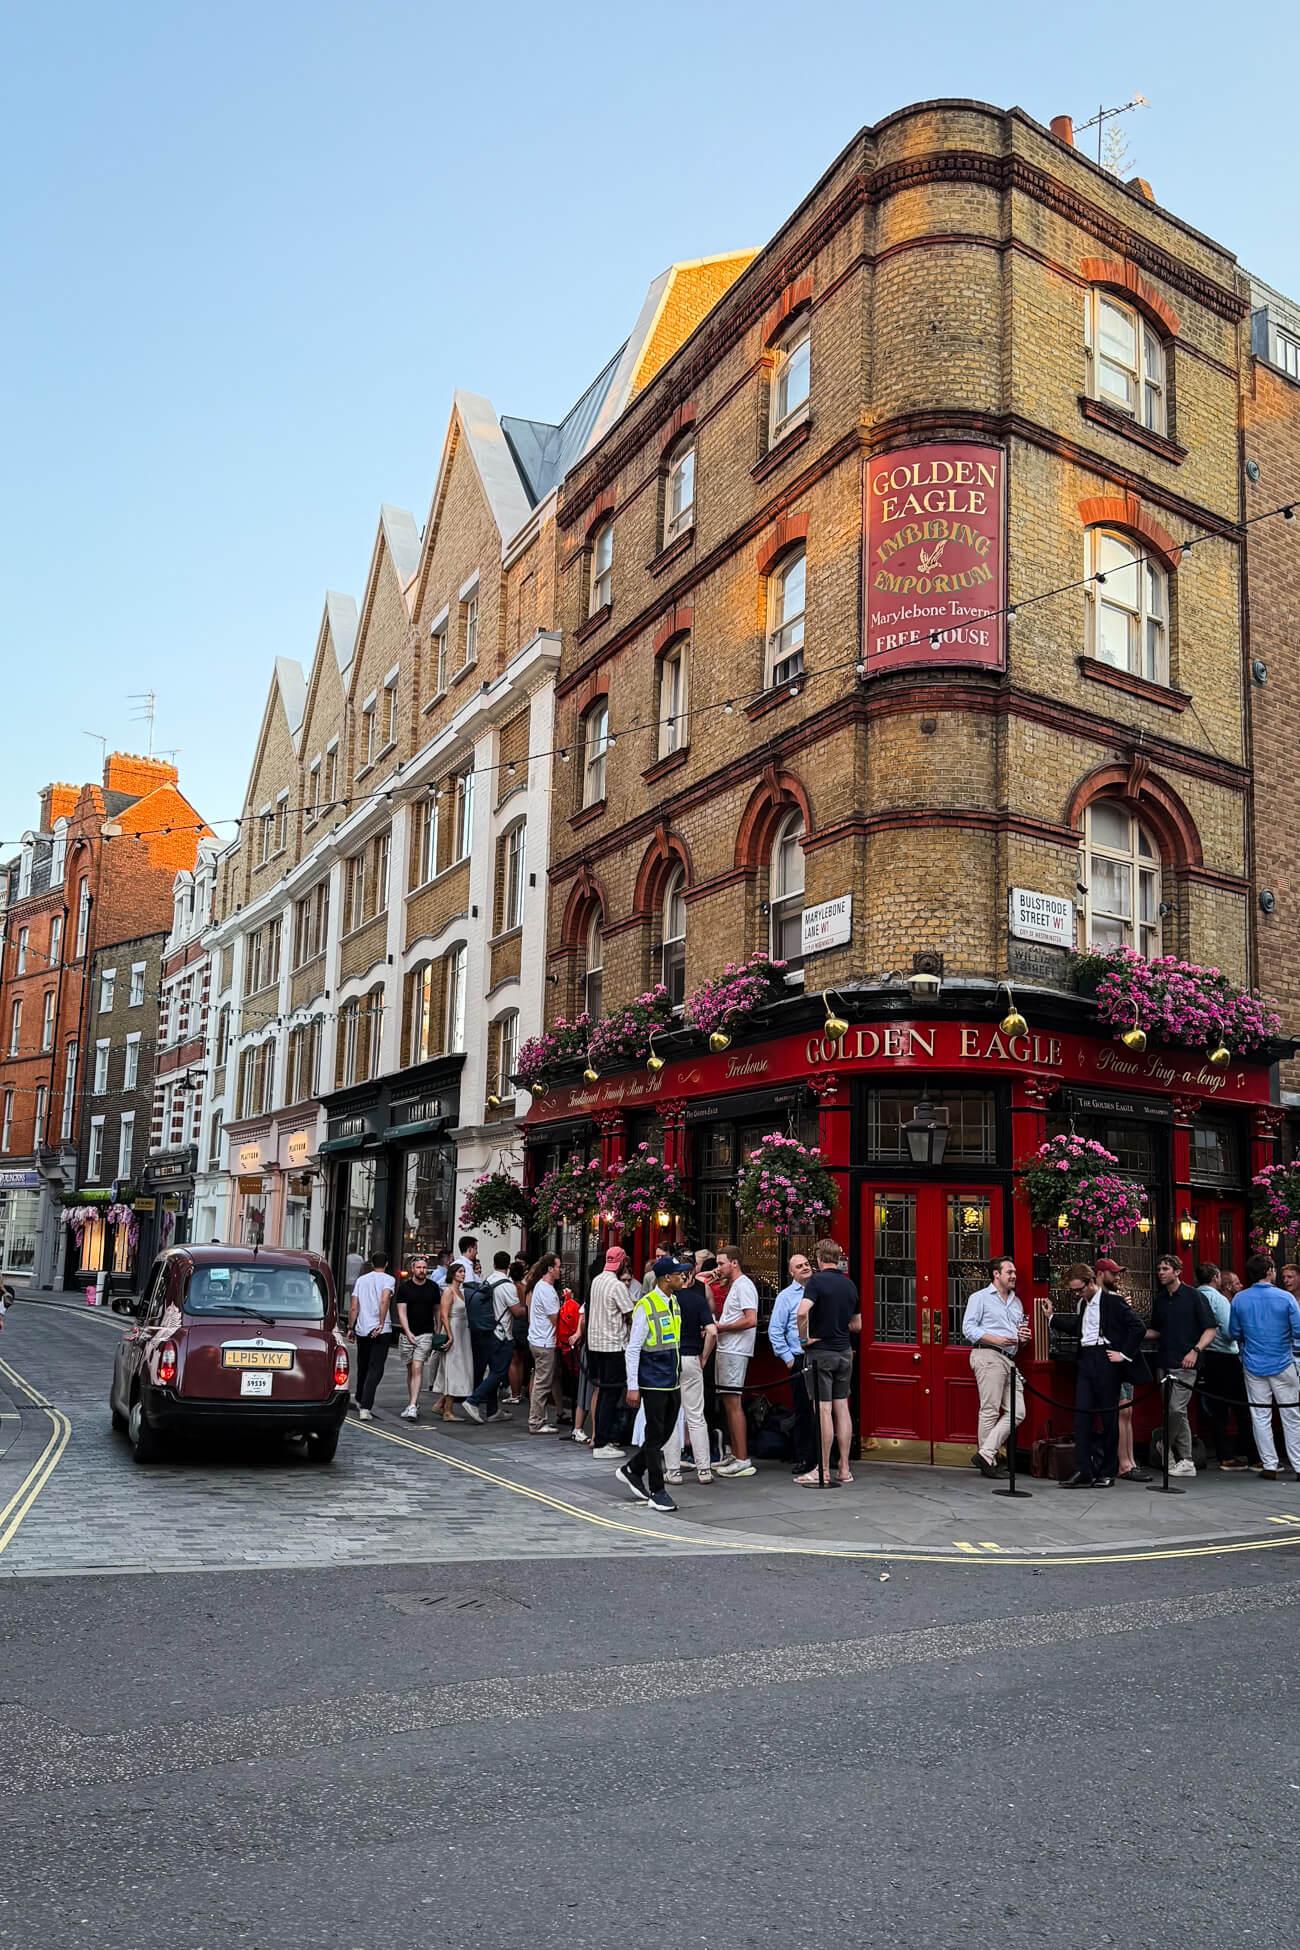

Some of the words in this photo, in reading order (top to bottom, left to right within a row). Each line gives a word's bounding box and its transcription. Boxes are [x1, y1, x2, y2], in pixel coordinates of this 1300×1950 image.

[872, 461, 998, 497] GOLDEN
[881, 489, 987, 524] EAGLE
[876, 518, 992, 564] IMBIBING
[873, 562, 993, 595] EMPORIUM
[871, 602, 947, 628] Marylebone
[948, 601, 998, 620] Taverns
[876, 629, 921, 653] FREE
[805, 901, 846, 925] MARYLEBONE
[1020, 894, 1067, 916] BULSTRODE
[804, 924, 819, 939] LANE
[821, 920, 829, 934] W1
[1020, 909, 1050, 927] STREET
[1053, 915, 1064, 930] W1
[805, 1028, 937, 1065] GOLDEN
[959, 1029, 1063, 1066] EAGLE
[1096, 1048, 1139, 1075] Piano
[1143, 1054, 1227, 1094] Sing-a-longs
[260, 1353, 284, 1365] YKY
